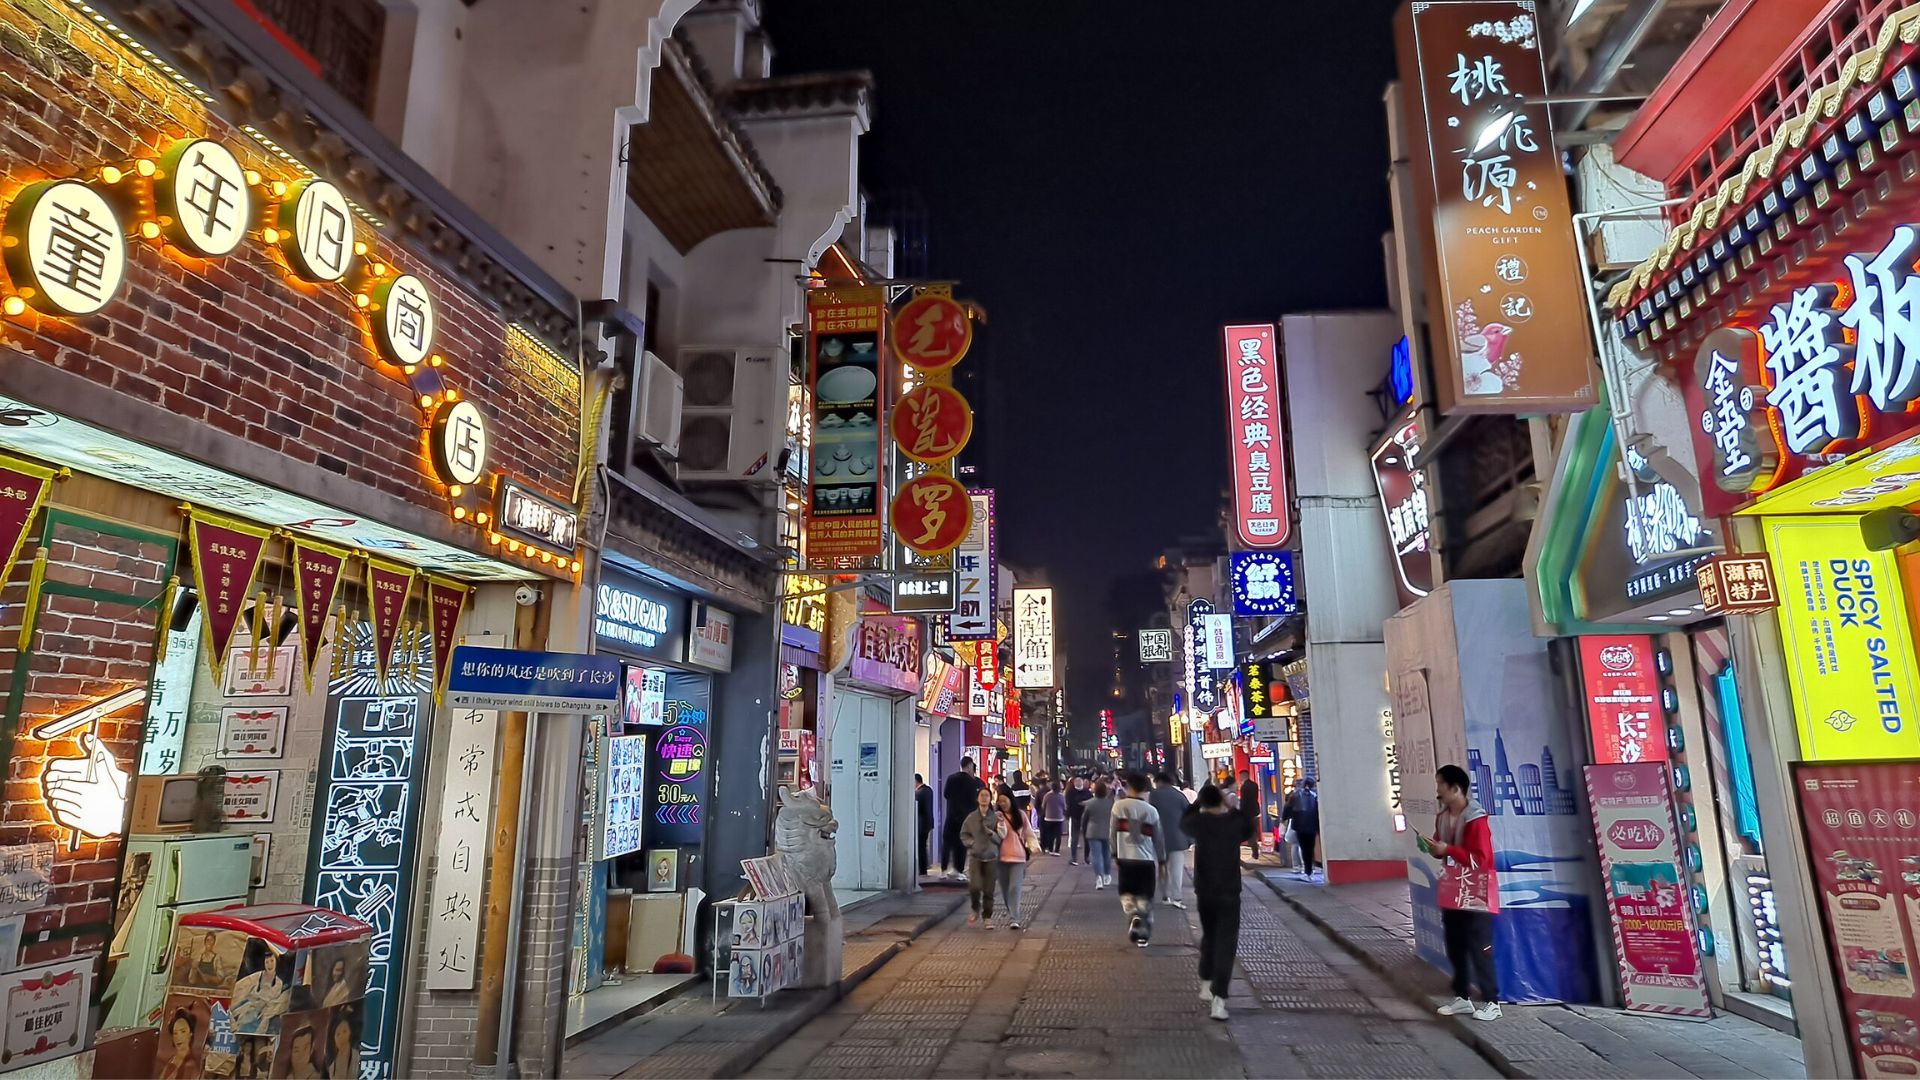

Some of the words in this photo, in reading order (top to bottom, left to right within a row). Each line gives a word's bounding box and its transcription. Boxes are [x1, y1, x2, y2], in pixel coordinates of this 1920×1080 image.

[1466, 226, 1499, 236] PEACH
[1502, 226, 1542, 235] GARDEN
[1492, 237, 1519, 245] GIFT
[38, 150, 480, 475] 童年旧商店
[1237, 338, 1273, 514] 黑色经典臭豆腐
[1725, 563, 1765, 582] 湖南
[1731, 581, 1768, 600] 特产
[1829, 558, 1859, 628] DUCK
[1851, 558, 1883, 631] SPICY
[1284, 603, 1296, 612] 2F
[344, 649, 425, 666] 童年商店
[980, 641, 995, 684] 臭豆腐
[461, 661, 615, 685] 想你的风还是吹到了长沙
[1866, 637, 1902, 733] SALTED
[476, 697, 491, 705] think
[493, 698, 507, 708] your
[536, 700, 553, 708] blows
[562, 702, 591, 712] Changsha
[781, 741, 797, 749] 饮料
[1611, 824, 1660, 842] 必吃榜
[24, 1011, 63, 1032] 最佳校草
